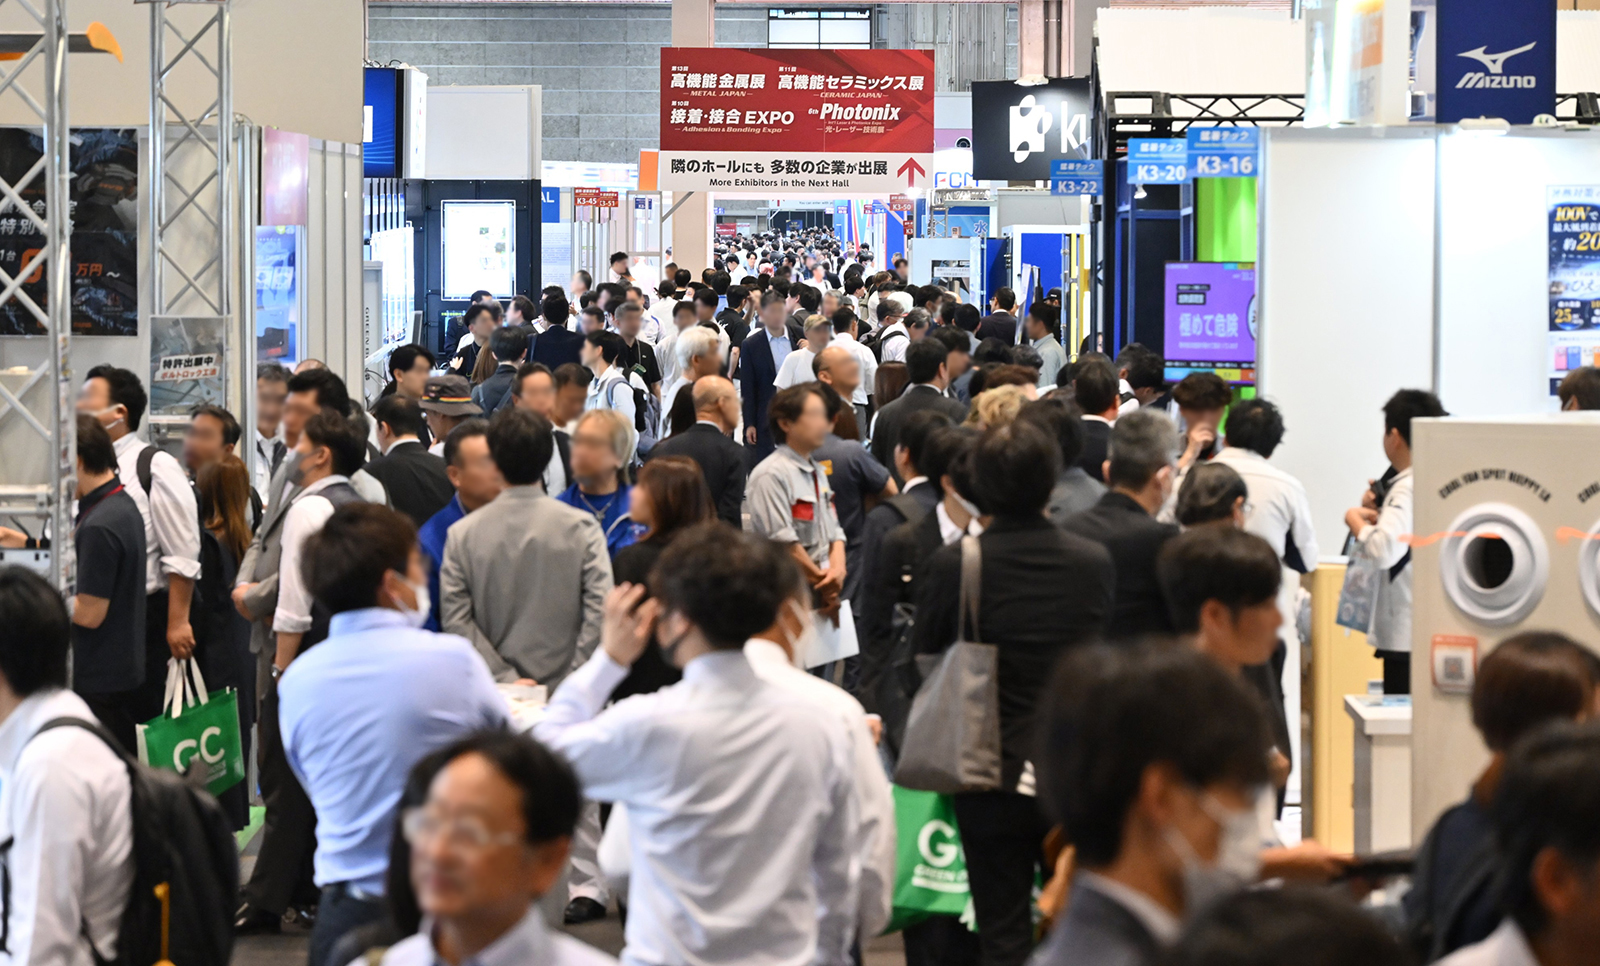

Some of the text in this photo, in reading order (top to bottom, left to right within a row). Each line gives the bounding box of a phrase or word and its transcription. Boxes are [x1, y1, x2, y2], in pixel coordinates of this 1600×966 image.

[670, 73, 766, 89] 高機能金属展
[778, 74, 925, 91] 高機能セラミックス展
[744, 110, 795, 125] EXPO
[820, 103, 902, 121] Photonix
[671, 158, 888, 175] 隣のホールにも 多数の企業が出展
[1196, 155, 1253, 174] K3-16
[1137, 164, 1187, 181] K3-20
[709, 178, 850, 187] More Exhibitors in the Next Hall
[1058, 180, 1098, 194] K3-22
[576, 197, 597, 205] K3-45
[892, 203, 912, 211] K3-50
[974, 220, 988, 234] 水
[1179, 312, 1239, 338] 極めて危険
[162, 356, 214, 370] 特許出願中
